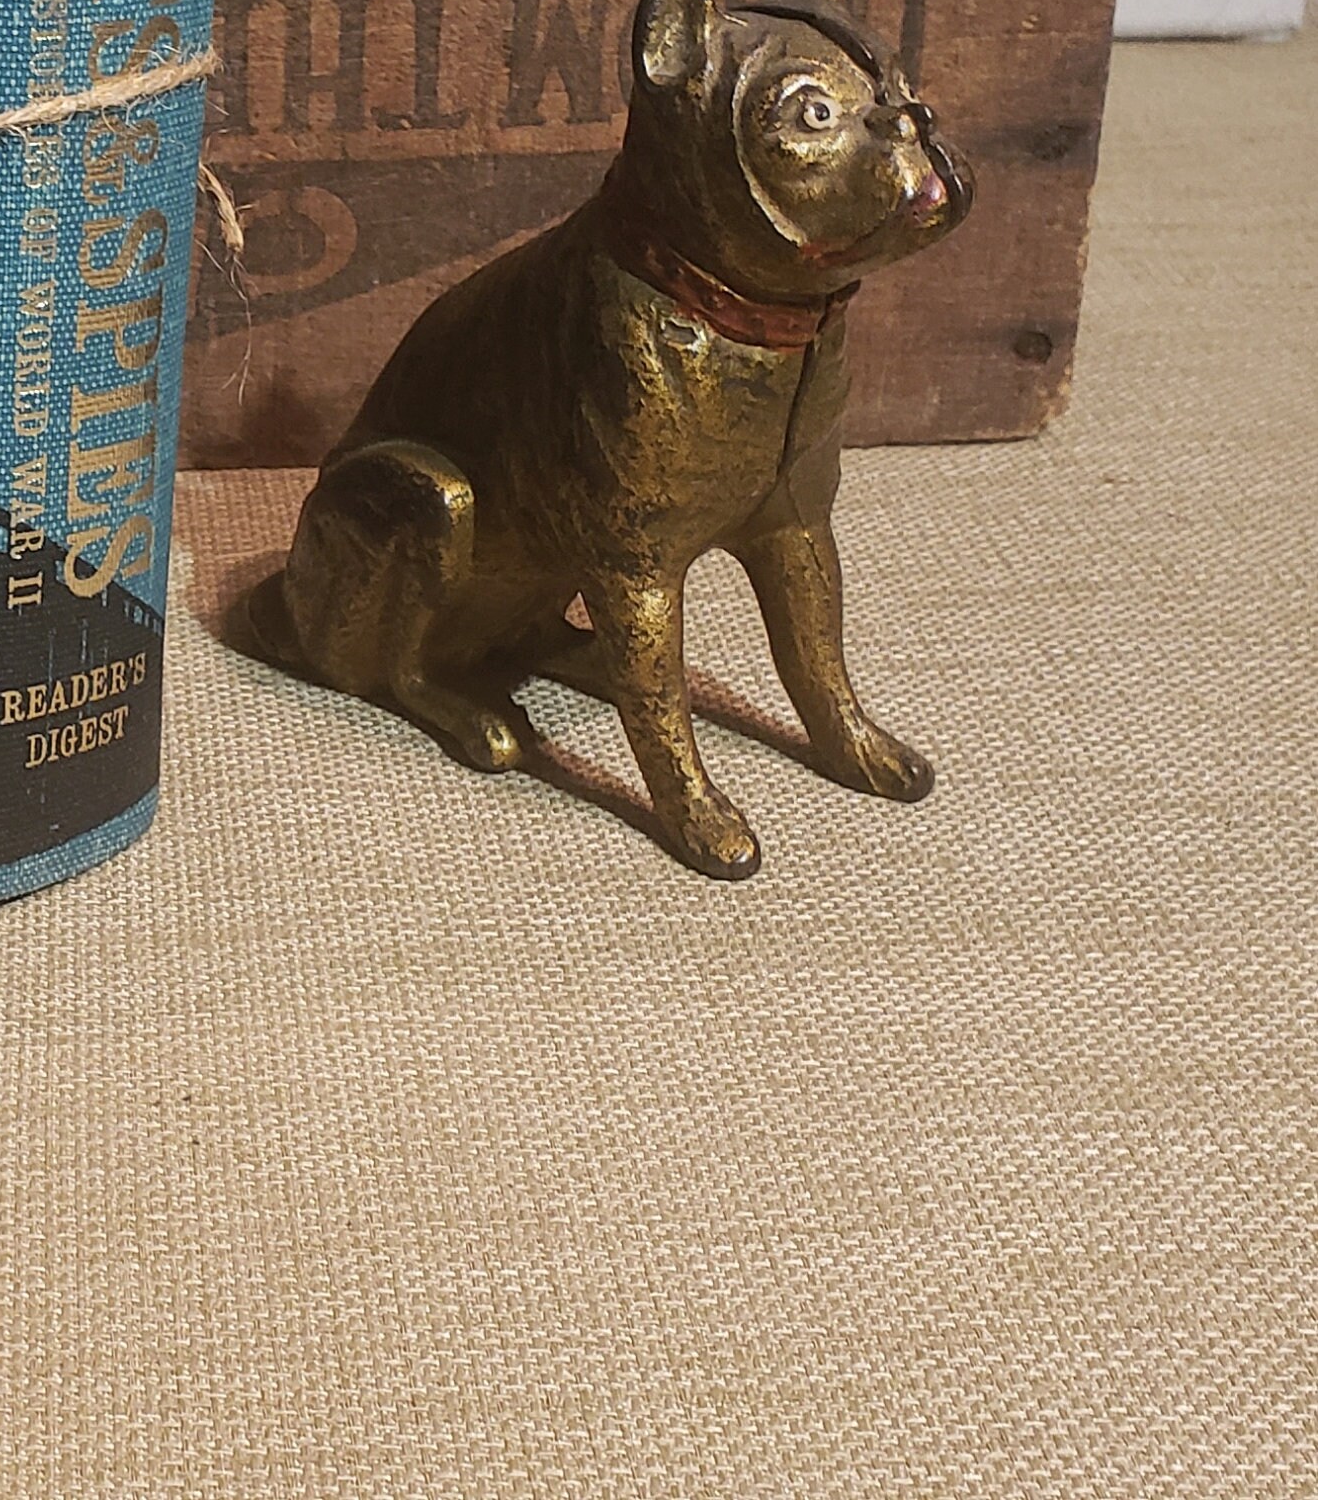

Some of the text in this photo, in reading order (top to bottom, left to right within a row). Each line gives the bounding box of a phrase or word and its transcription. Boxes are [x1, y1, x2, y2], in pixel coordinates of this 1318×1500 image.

[19, 208, 59, 264] OF
[13, 278, 57, 438] WORLD
[64, 207, 169, 598] SPIES
[8, 452, 48, 560] WAR
[7, 571, 44, 610] II
[24, 704, 130, 770] DIGEST
